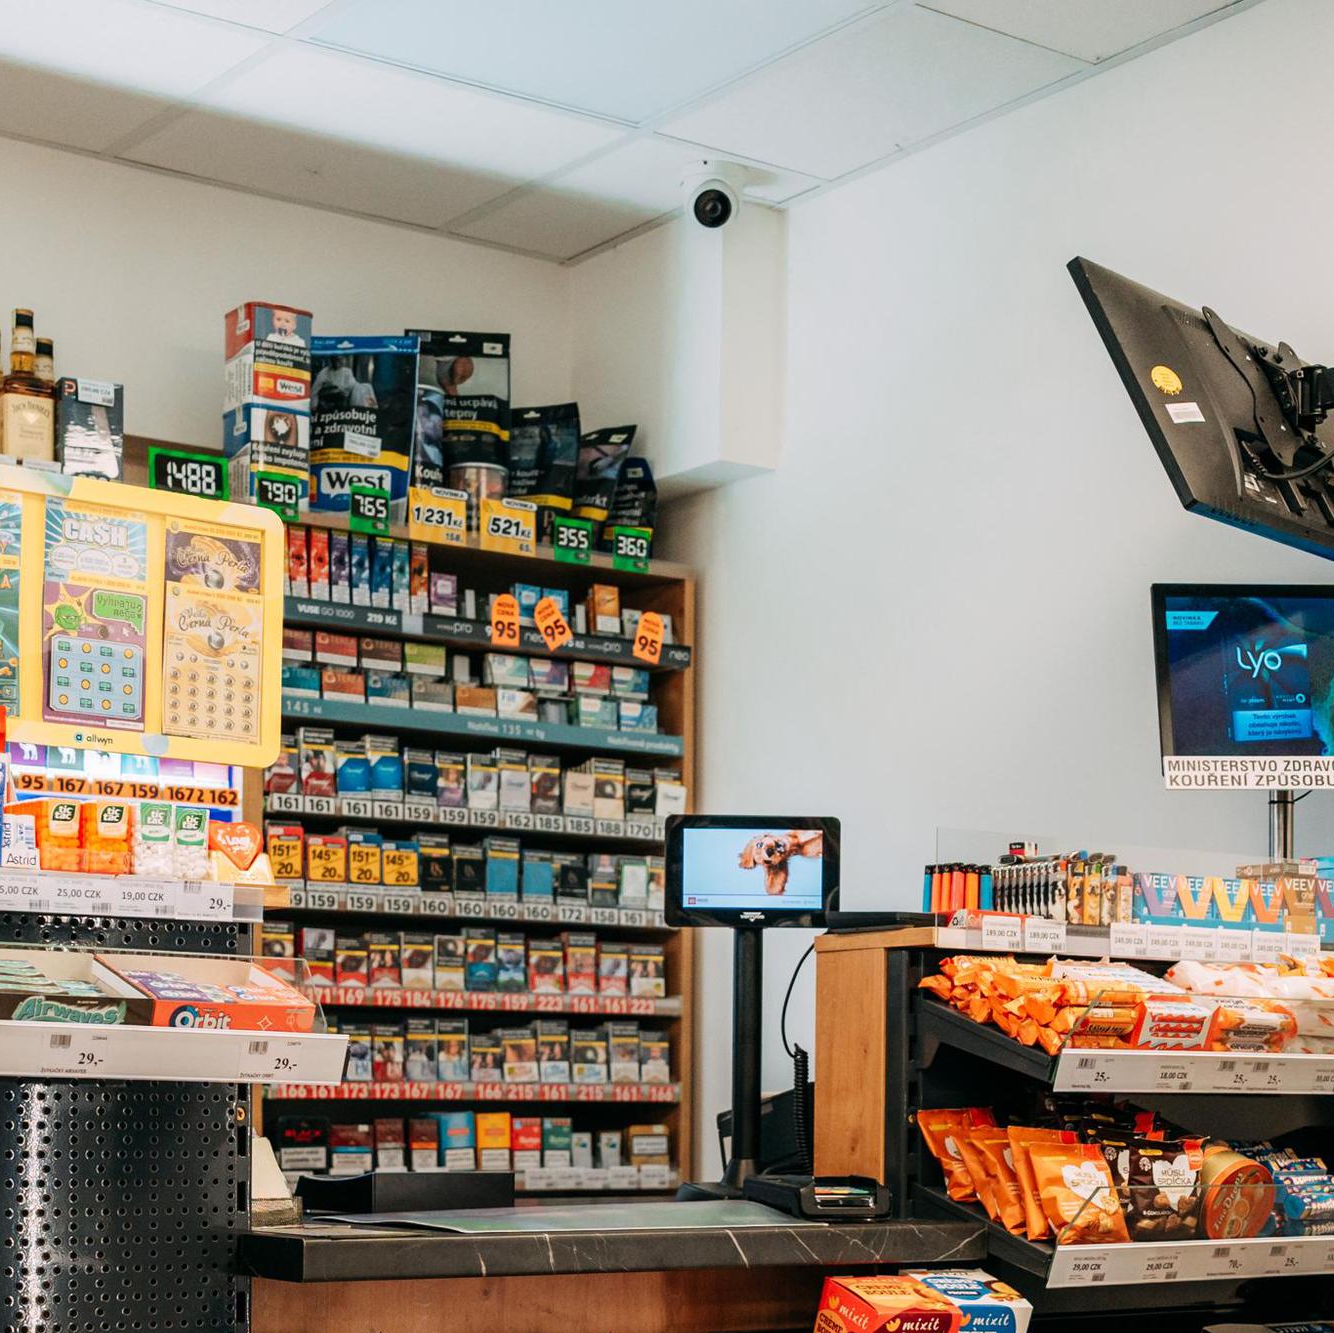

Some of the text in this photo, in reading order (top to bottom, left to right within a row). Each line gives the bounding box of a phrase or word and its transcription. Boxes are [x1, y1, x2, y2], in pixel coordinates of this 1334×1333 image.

[320, 408, 376, 424] způsobuje
[445, 409, 478, 421] tepny
[323, 422, 377, 437] zdravotní
[166, 461, 217, 496] 1488
[262, 480, 297, 504] 790
[354, 494, 388, 519] 765
[490, 517, 520, 538] 521
[558, 527, 589, 549] 355
[617, 536, 647, 558] 360
[495, 620, 517, 639] 95
[544, 620, 566, 642] 95
[86, 733, 113, 745] allwyn
[1168, 759, 1278, 772] MINISTERSTVO
[22, 775, 44, 790] 95
[57, 777, 86, 793] 167
[1169, 773, 1248, 787] KOUŘENÍ
[129, 783, 159, 799] 159
[208, 789, 238, 806] 162
[54, 803, 71, 814] tic
[277, 796, 300, 811] 161
[52, 810, 72, 822] tac
[408, 806, 431, 821] 159
[508, 813, 531, 829] 162
[539, 816, 560, 831] 185
[6, 853, 37, 867] Astrid
[20, 885, 39, 896] CZK
[1284, 878, 1316, 892] VEEV
[122, 891, 164, 902] 19,00 CZK
[311, 893, 336, 908] 159
[423, 899, 447, 914] 160
[594, 909, 616, 924] 158
[377, 990, 401, 1007] 175
[537, 996, 563, 1011] 223
[12, 996, 126, 1025] Airwaves
[170, 1005, 231, 1029] Orbit
[79, 1053, 104, 1067] 29,-
[377, 1083, 400, 1099] 173
[902, 1316, 940, 1332] mixit
